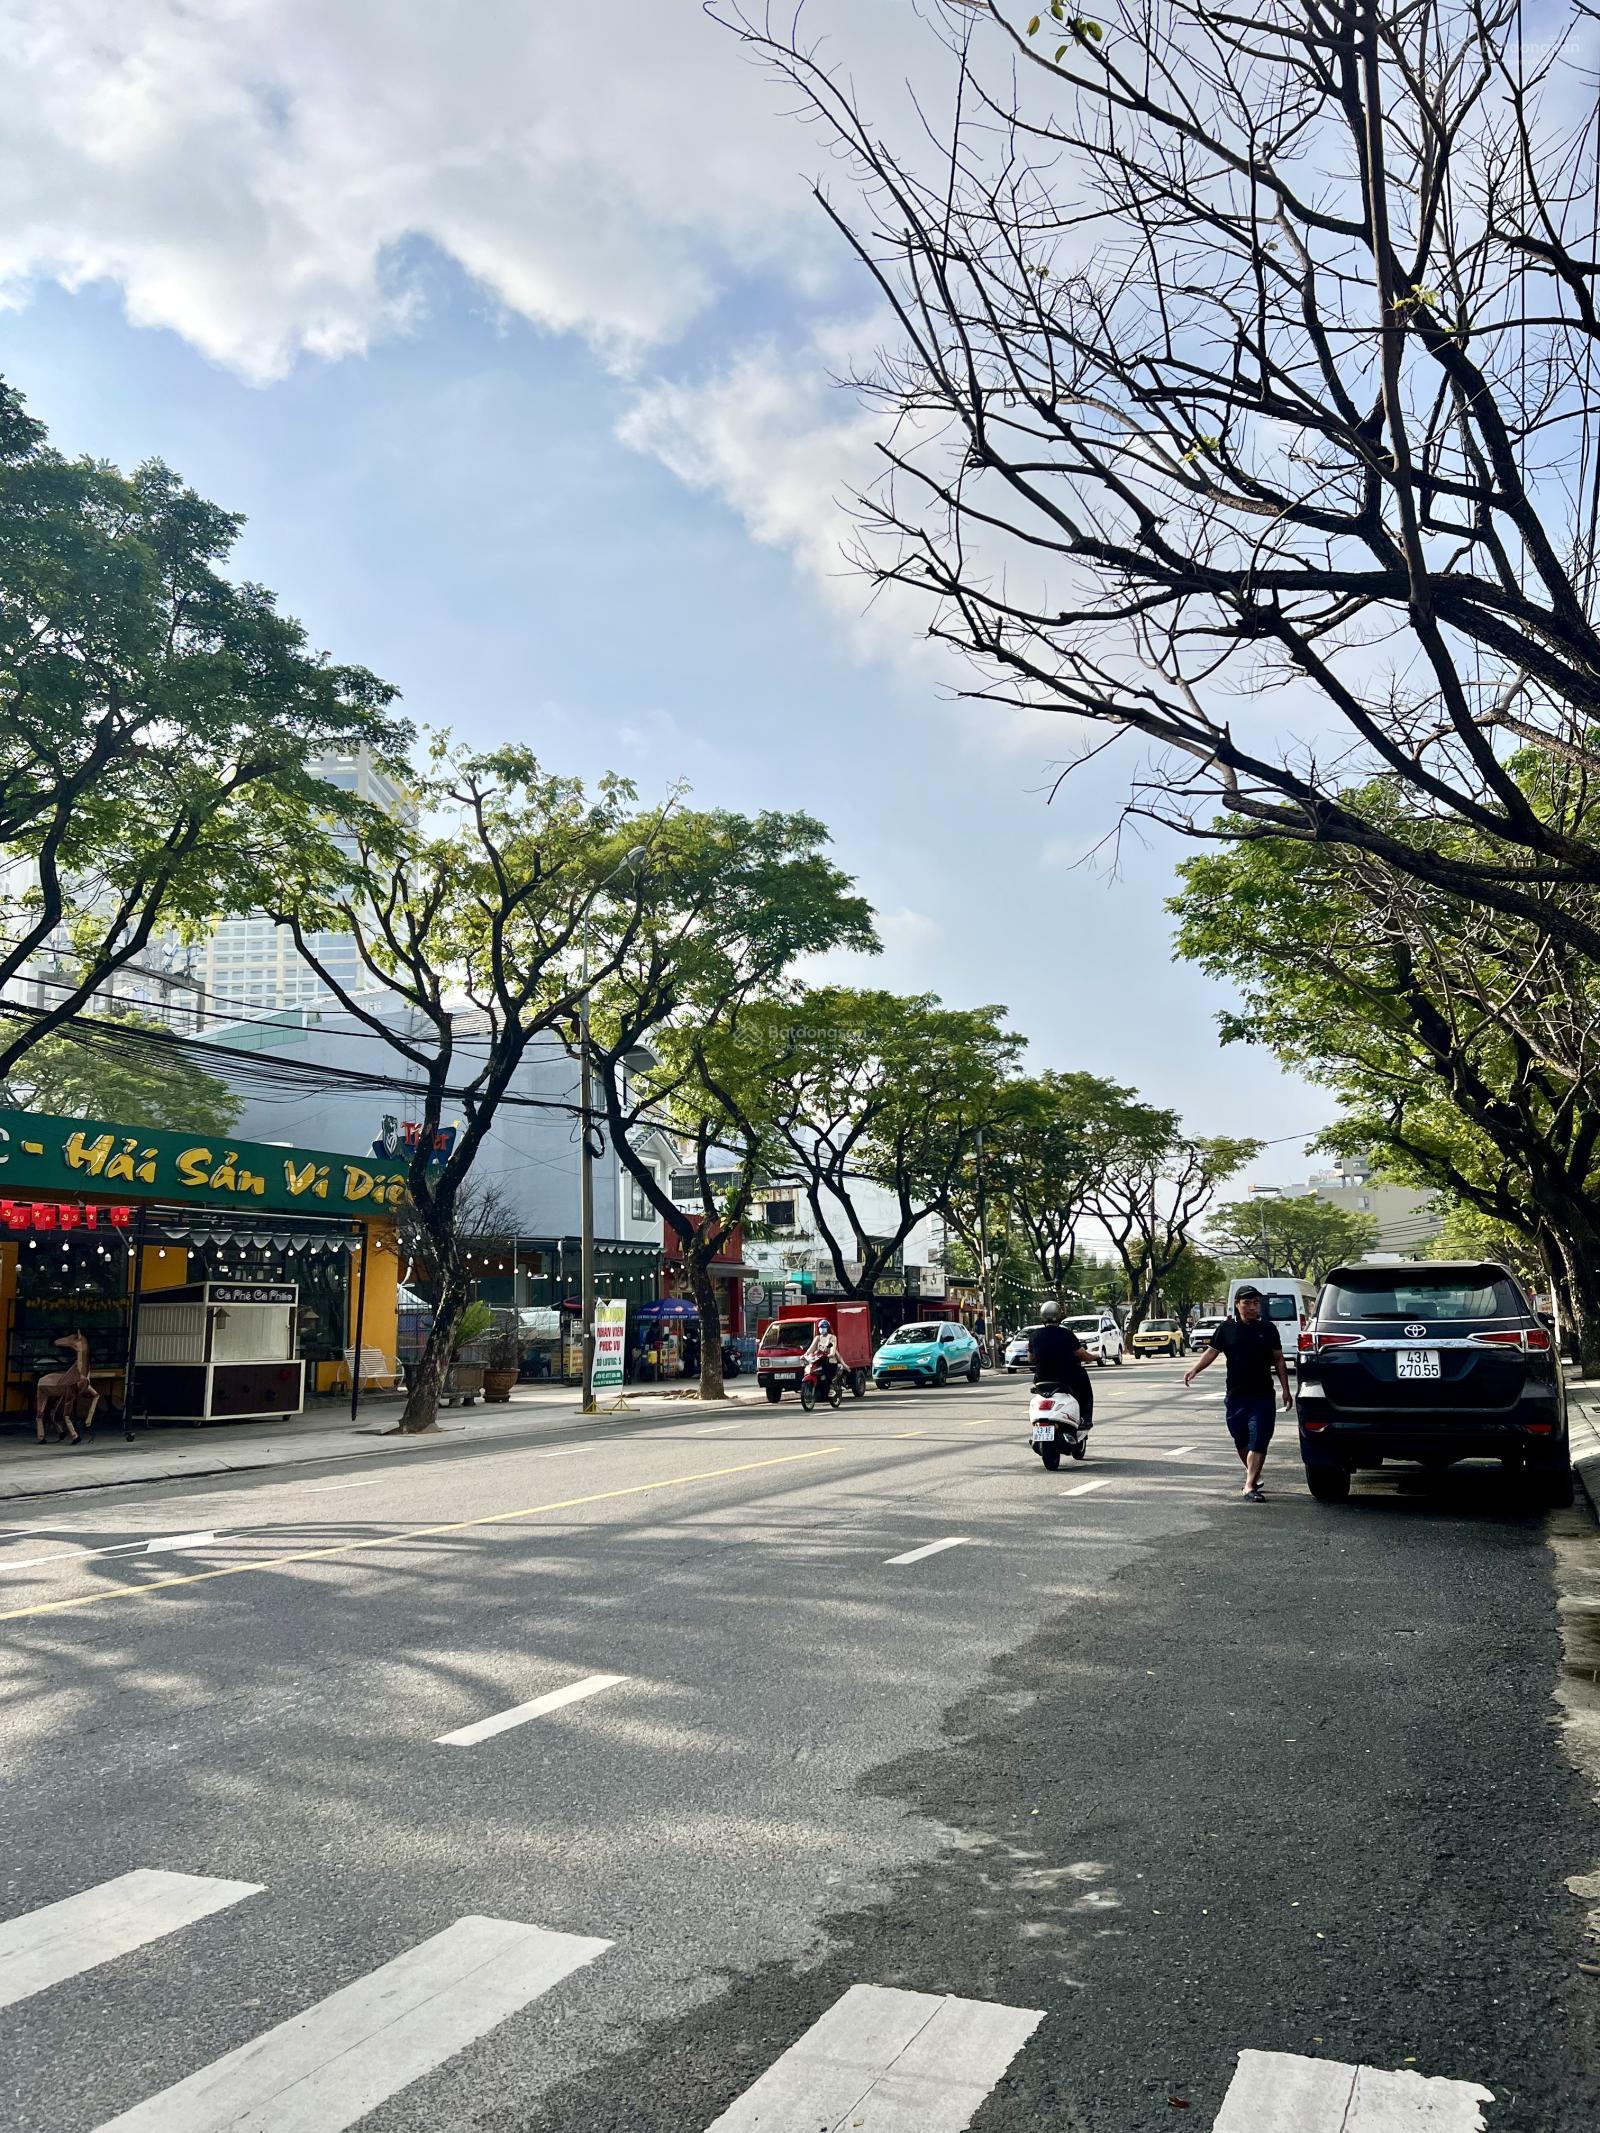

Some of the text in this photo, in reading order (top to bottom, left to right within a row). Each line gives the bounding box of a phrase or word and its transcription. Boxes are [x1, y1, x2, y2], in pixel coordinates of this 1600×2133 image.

[62, 1131, 159, 1184] Hải
[175, 1148, 265, 1195] Sản
[1407, 1351, 1429, 1364] 43A
[1399, 1364, 1439, 1377] 270.55
